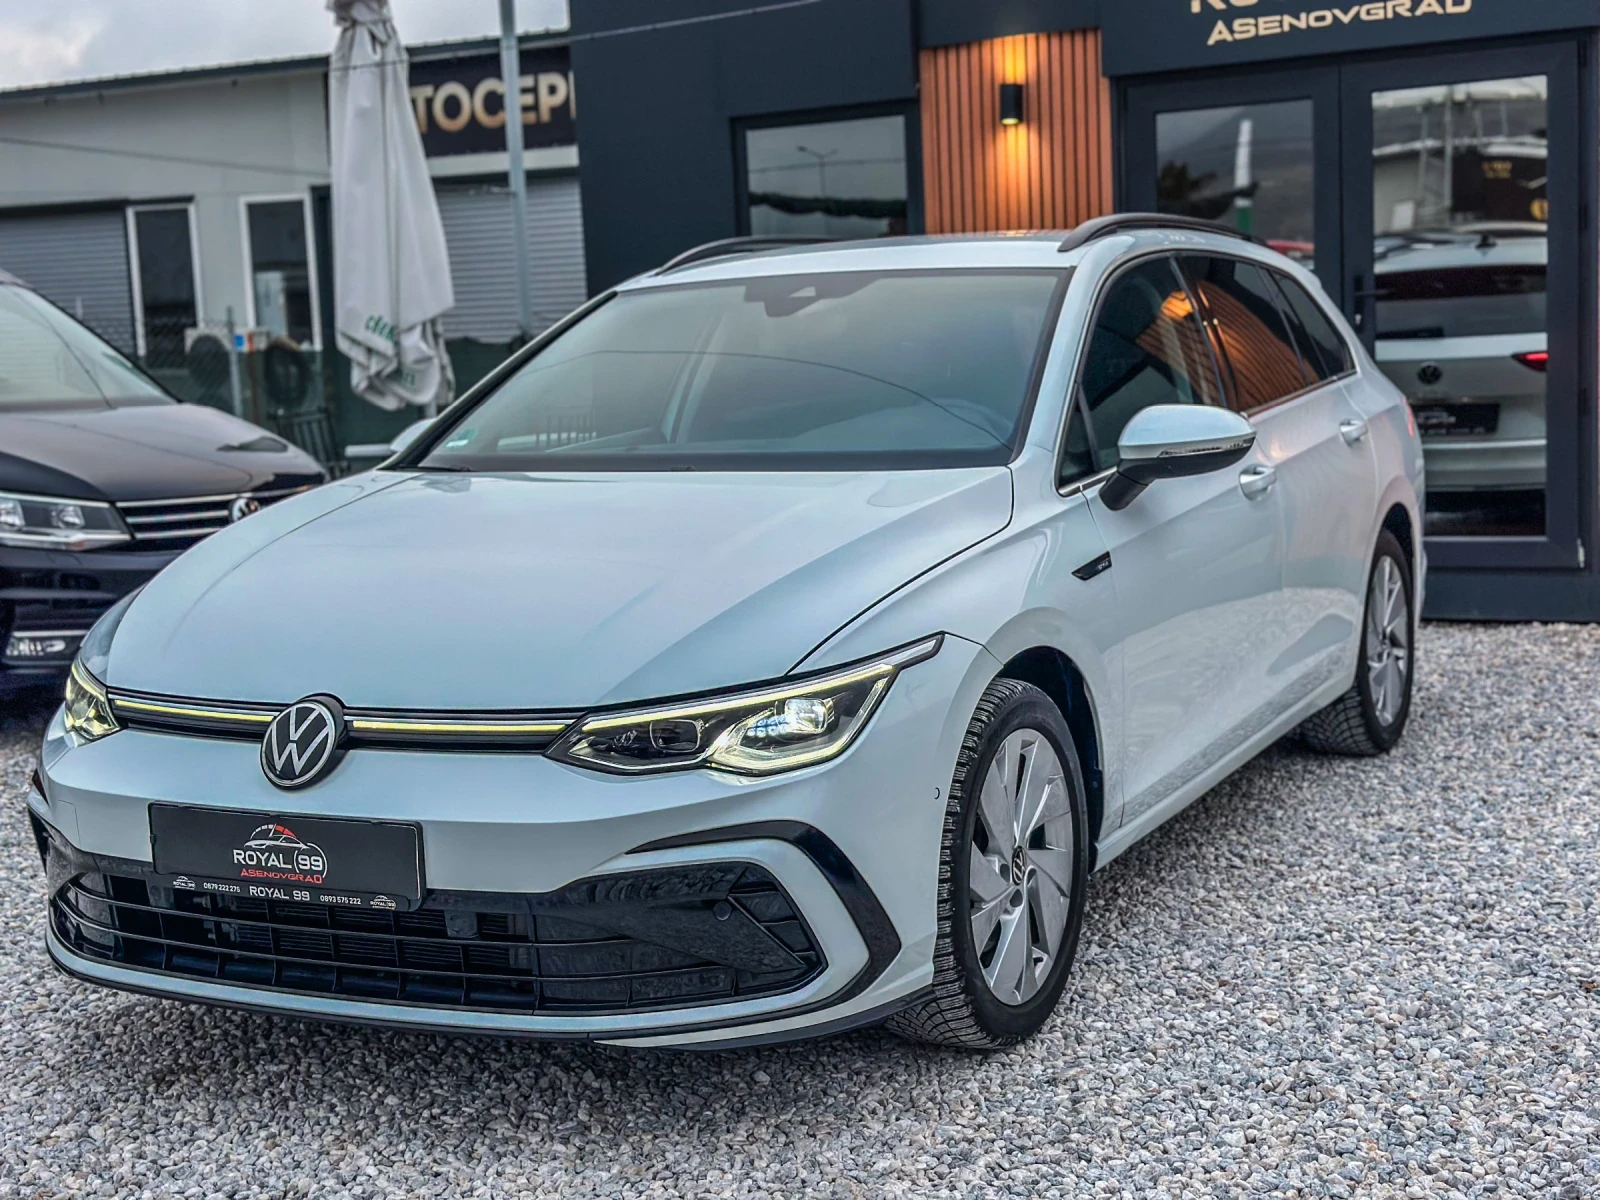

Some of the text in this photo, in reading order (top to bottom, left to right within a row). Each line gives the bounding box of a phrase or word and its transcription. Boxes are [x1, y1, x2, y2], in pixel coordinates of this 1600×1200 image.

[1207, 0, 1473, 46] ASENOVGRAD
[409, 71, 576, 134] ТОСЕР
[233, 849, 292, 869] ROYAL
[241, 868, 322, 884] ASENOVGRAD
[218, 884, 230, 892] 222
[249, 886, 310, 901] ROYAL 99
[320, 894, 337, 903] 0893
[349, 897, 362, 905] 222
